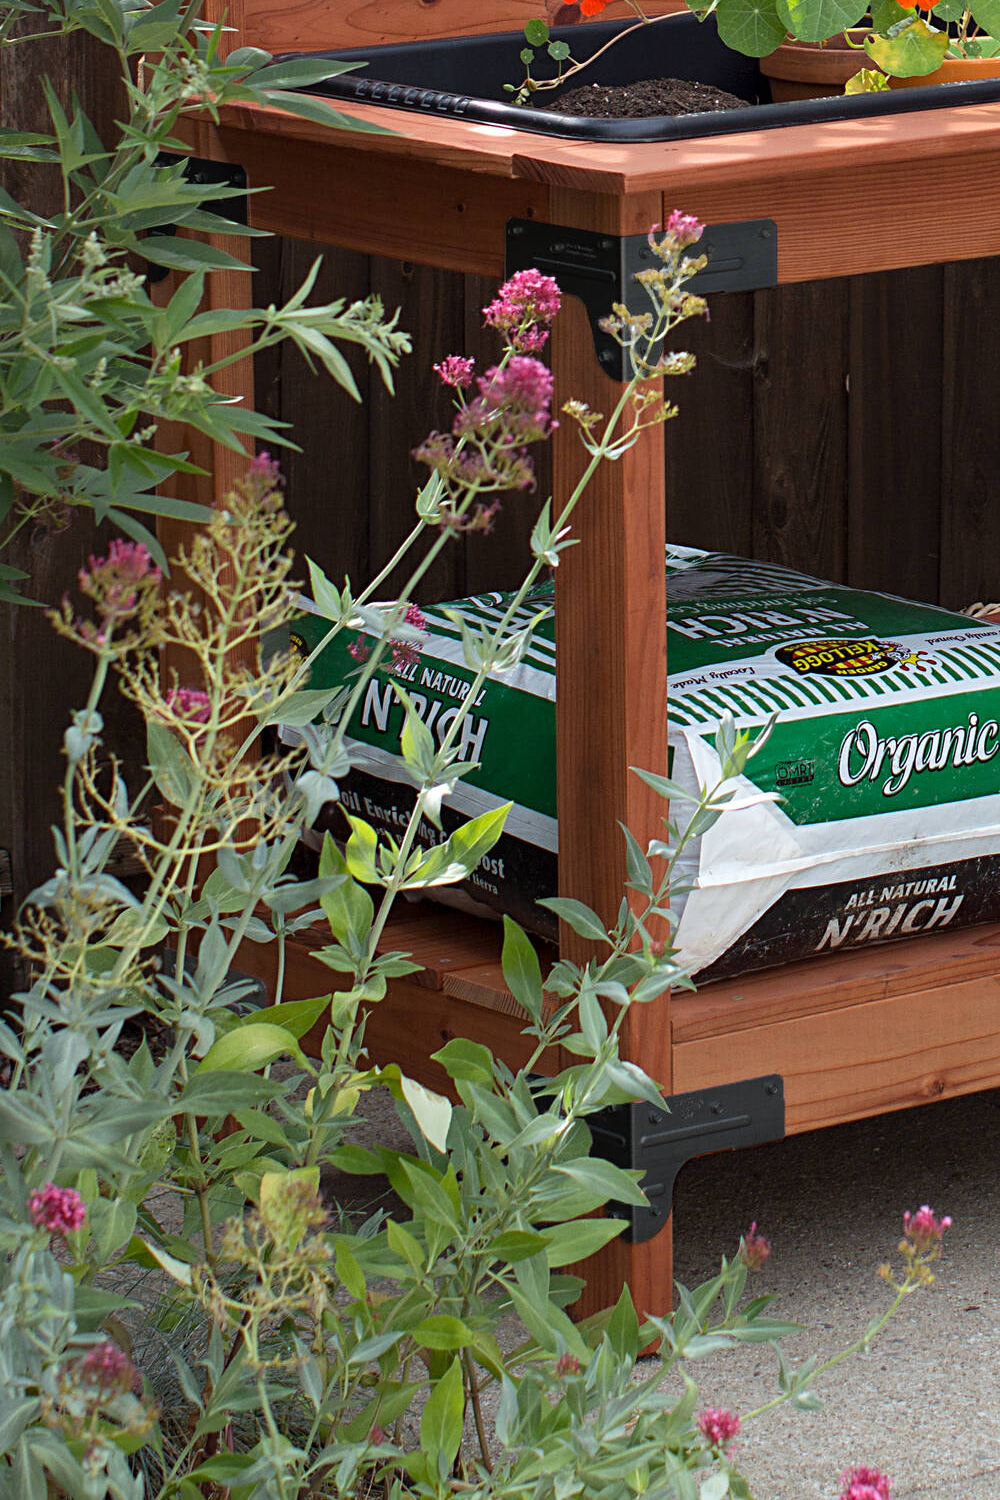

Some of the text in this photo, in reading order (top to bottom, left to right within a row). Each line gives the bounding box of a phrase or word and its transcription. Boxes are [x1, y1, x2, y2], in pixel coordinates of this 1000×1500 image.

[666, 606, 856, 640] N'RICH
[709, 621, 870, 647] ALL NATURAL
[924, 634, 965, 646] Owned
[793, 640, 880, 671] KELLOGG
[837, 661, 888, 675] GARDEN
[671, 667, 755, 690] Locally Made
[838, 711, 1000, 797] Organic
[341, 790, 361, 812] oil
[844, 874, 957, 910] ALL NATURAL
[814, 894, 965, 951] N'RICH
